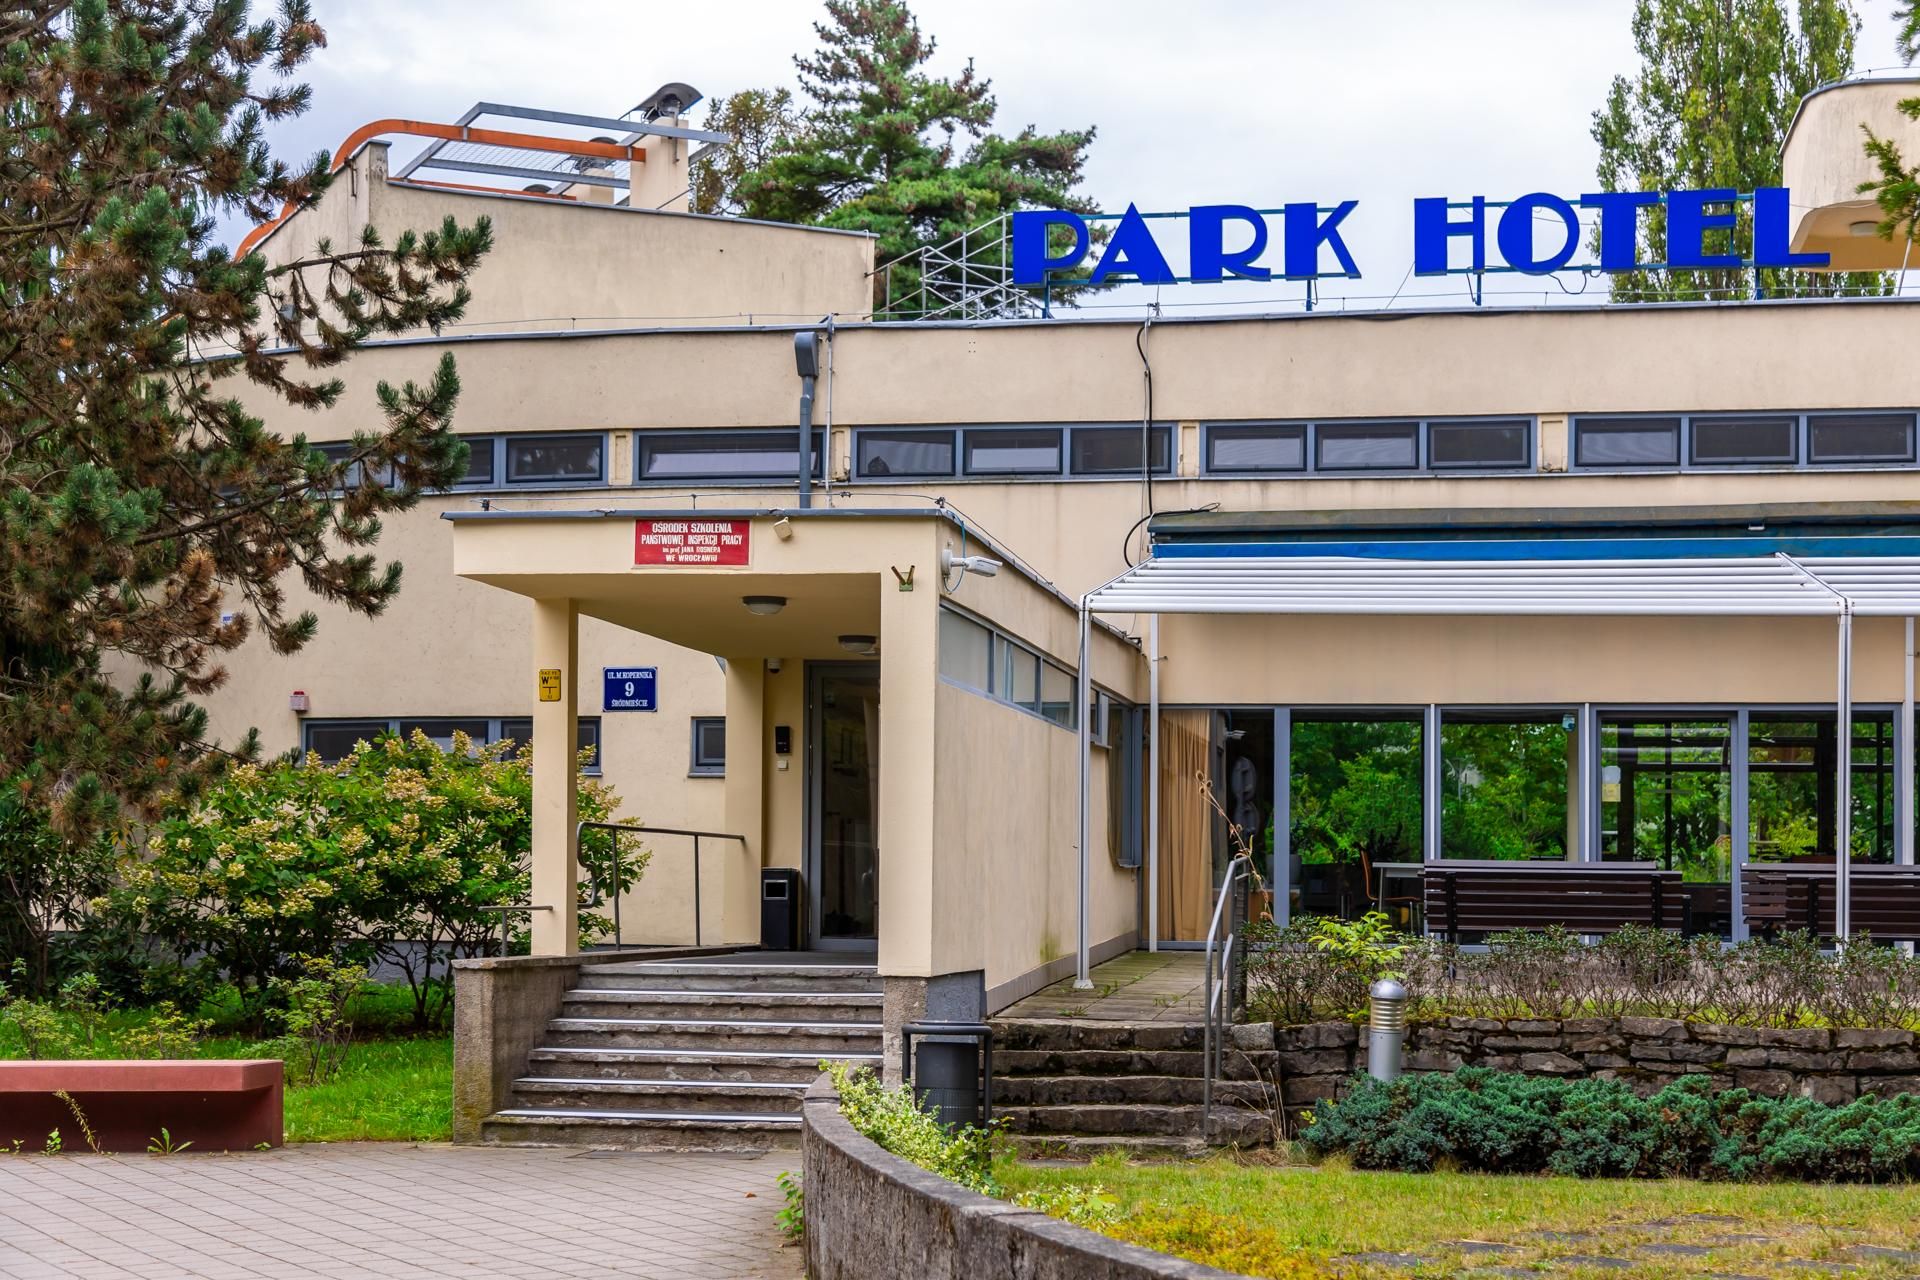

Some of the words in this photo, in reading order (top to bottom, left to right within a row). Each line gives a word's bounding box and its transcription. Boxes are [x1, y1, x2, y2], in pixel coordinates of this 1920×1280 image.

[1013, 201, 1361, 286] PARK
[1414, 188, 1830, 276] HOTEL
[652, 522, 689, 533] OŚRODEK
[691, 523, 732, 533] SZKOLENIA
[641, 533, 684, 545] PAŃSTWOWEJ
[721, 534, 742, 545] PRACY
[678, 554, 718, 562] WROCŁAWIU
[622, 671, 653, 679] KOPERNIKA
[625, 681, 635, 697] 9
[611, 699, 648, 707] ŚRÓDMIEŚCIE
